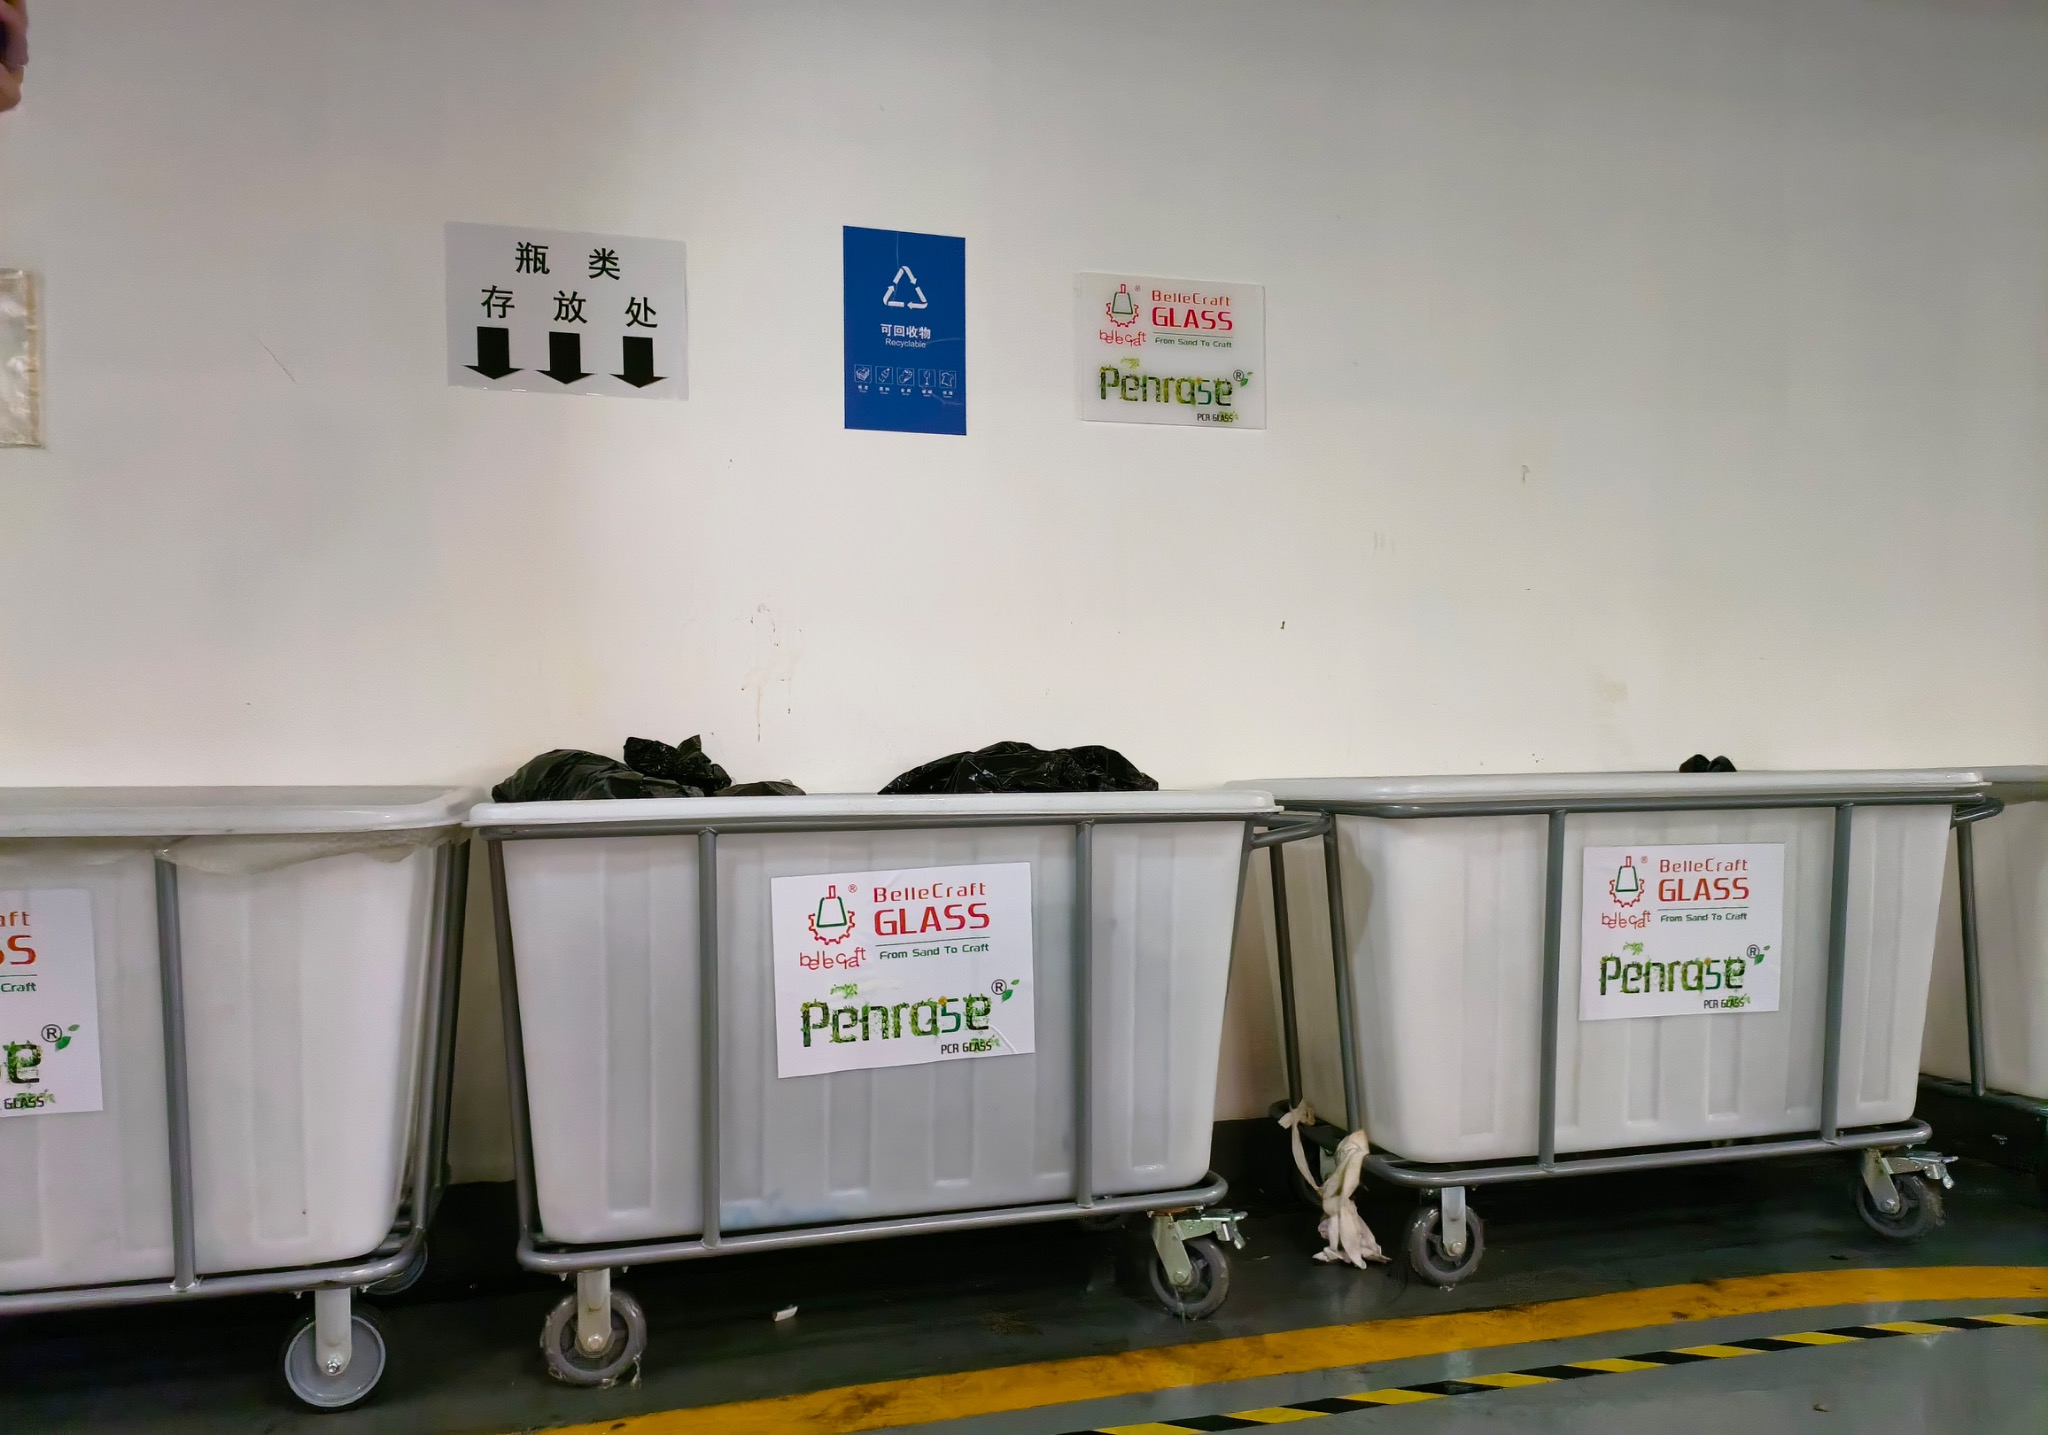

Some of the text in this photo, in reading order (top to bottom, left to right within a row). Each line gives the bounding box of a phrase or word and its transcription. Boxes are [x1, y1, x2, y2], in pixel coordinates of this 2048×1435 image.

[1152, 290, 1230, 307] BelleCraft
[1152, 307, 1233, 331] GLASS
[880, 323, 931, 339] 可回收物
[885, 338, 926, 348] Recyclable
[1155, 337, 1174, 345] From
[1197, 413, 1233, 422] PCR GLASS
[1660, 858, 1748, 873] BelleCraft
[873, 883, 986, 903] BelleCraft
[1658, 877, 1750, 902] GLASS
[874, 903, 990, 936] GLASS
[1686, 914, 1708, 922] Sand
[1711, 913, 1722, 921] To
[1726, 912, 1747, 920] Craft
[880, 943, 989, 959] From Sand To Craft
[0, 982, 37, 992] Craft
[1704, 999, 1745, 1009] PCR GLASS
[940, 1041, 992, 1054] PCR GLASS
